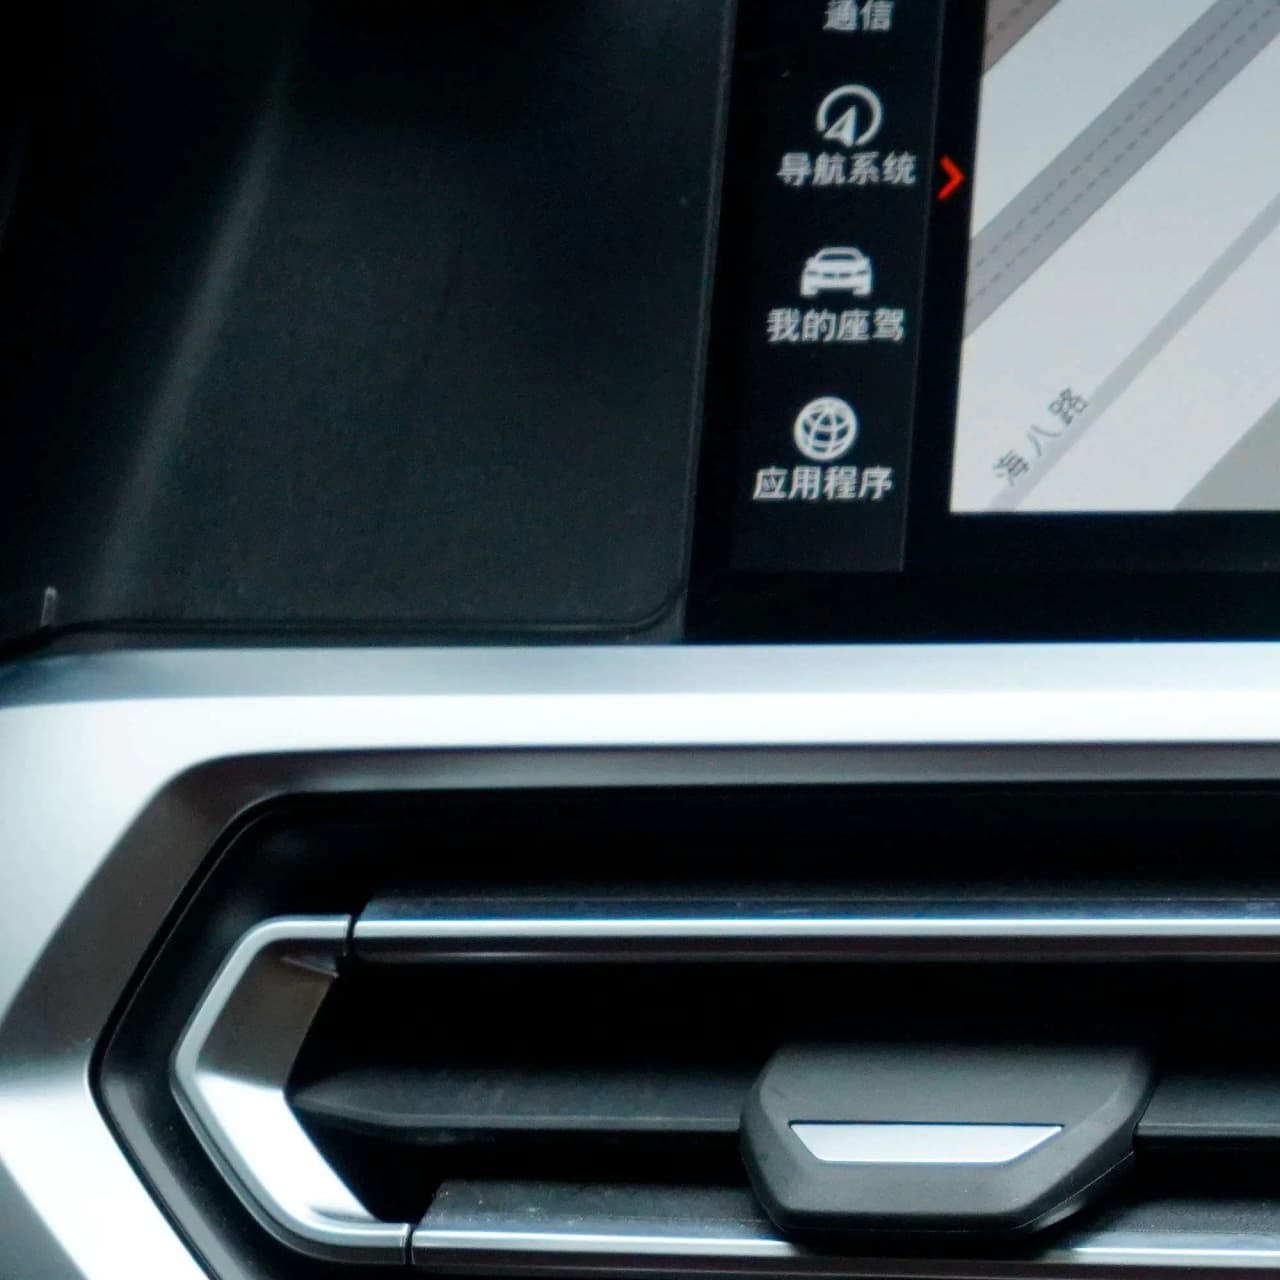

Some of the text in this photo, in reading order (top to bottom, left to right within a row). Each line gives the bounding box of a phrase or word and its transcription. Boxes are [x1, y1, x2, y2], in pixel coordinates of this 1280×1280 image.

[823, 0, 893, 31] 通信
[776, 151, 917, 187] 导航系统
[766, 307, 906, 344] 我的座驾
[992, 386, 1090, 487] 海八路
[752, 465, 894, 502] 应用程序
